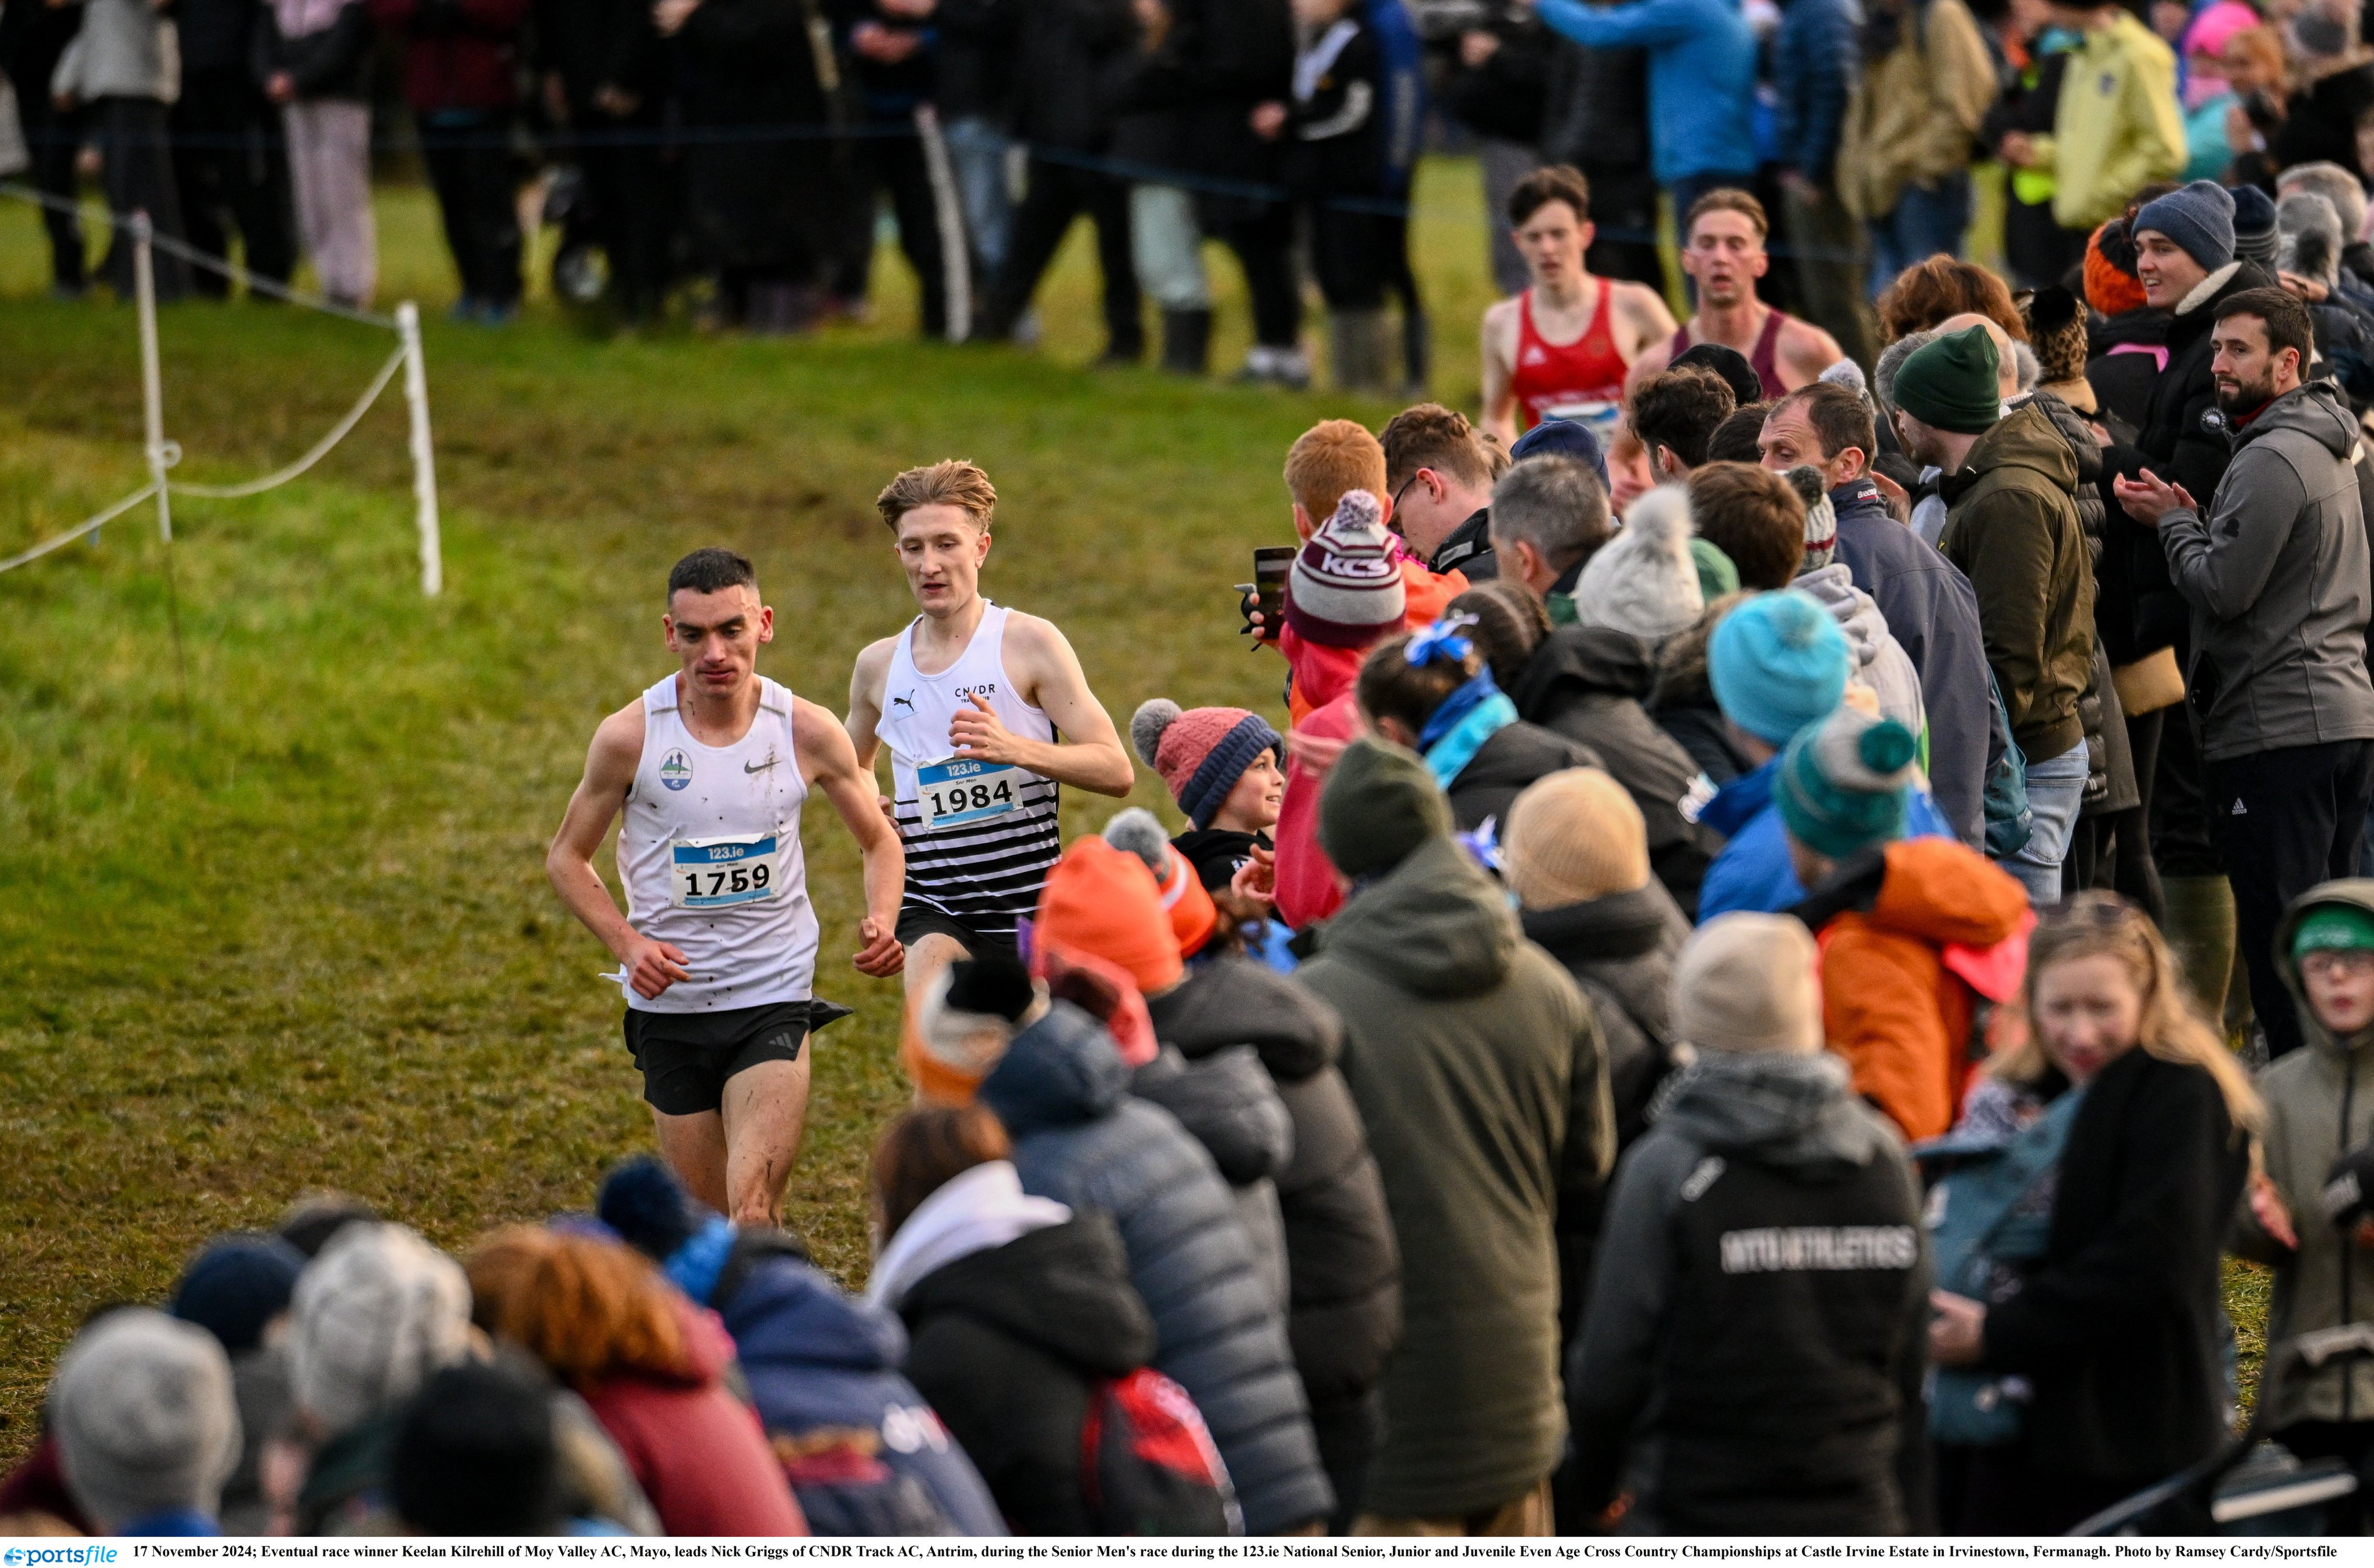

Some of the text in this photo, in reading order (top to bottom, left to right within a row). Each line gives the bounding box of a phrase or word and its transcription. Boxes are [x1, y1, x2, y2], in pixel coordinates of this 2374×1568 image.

[1321, 552, 1390, 577] KCS
[946, 761, 981, 777] 123.ie
[931, 779, 1013, 816] 1984
[708, 846, 745, 860] 123.ie
[685, 863, 770, 896] 1759
